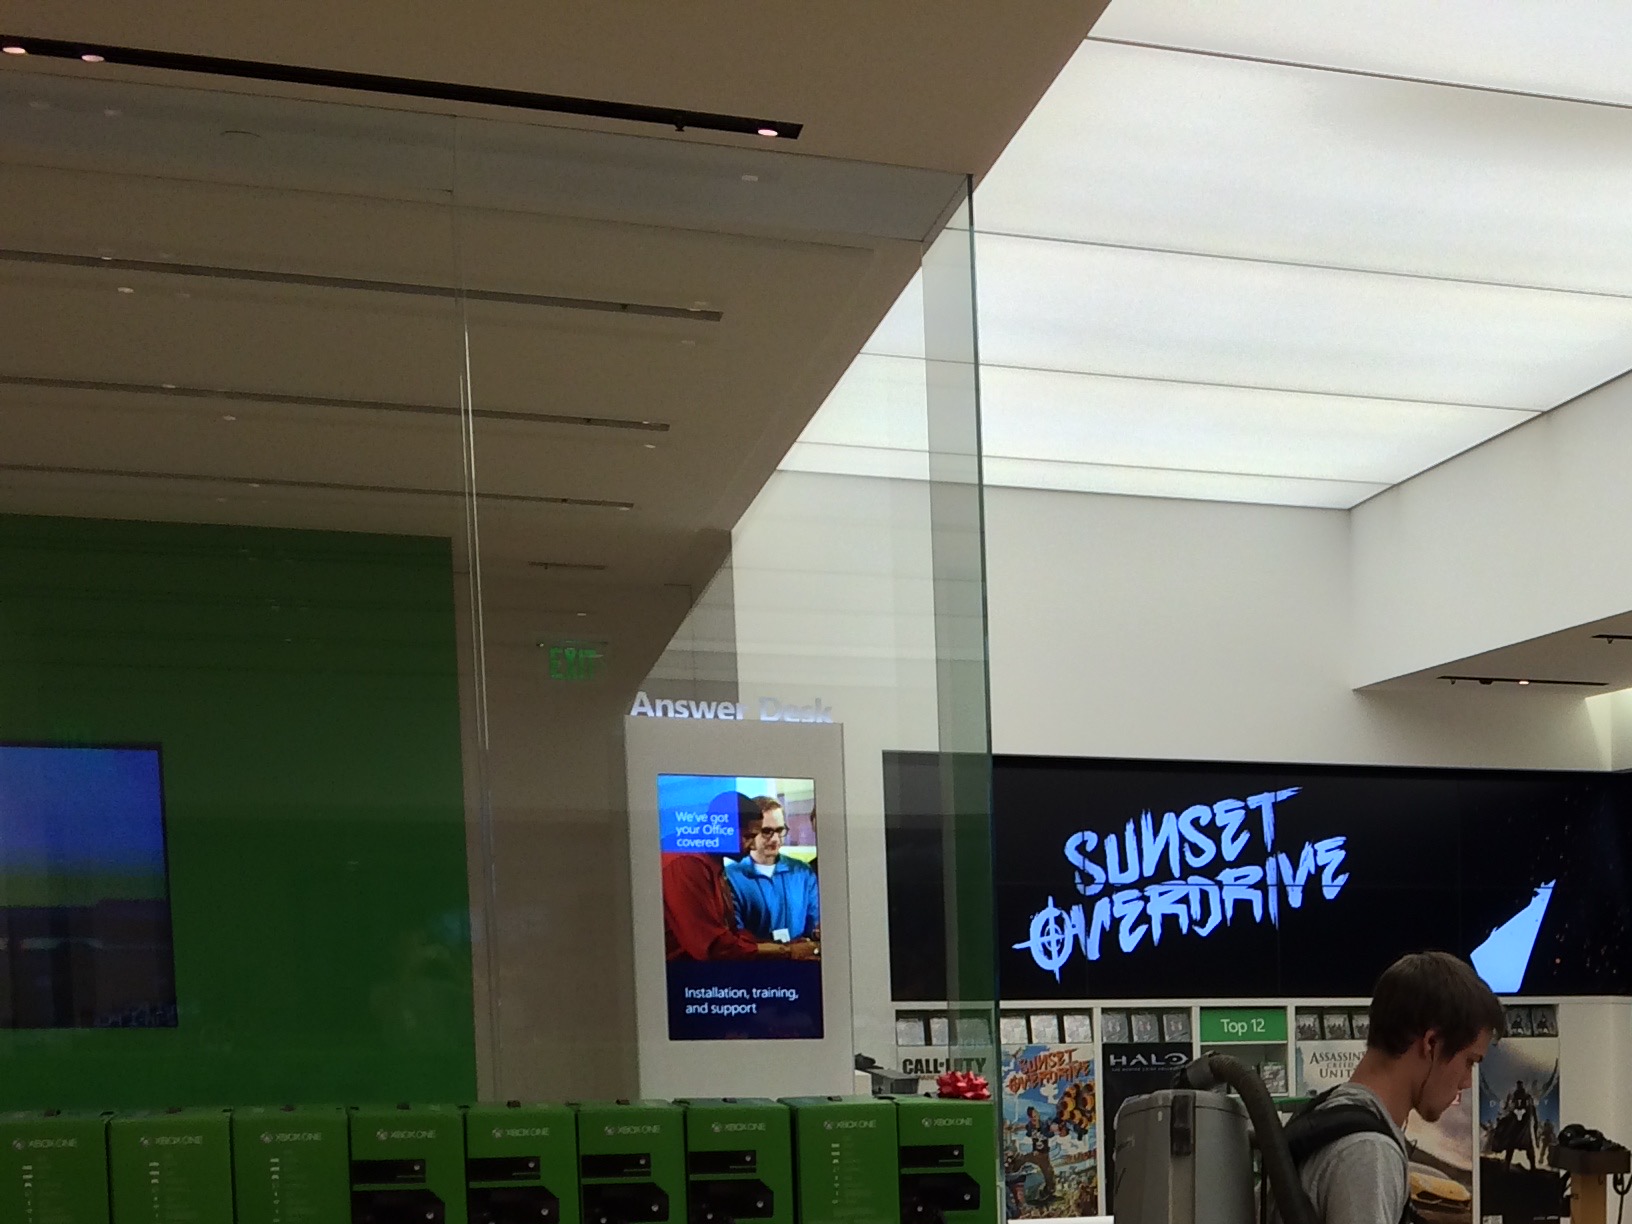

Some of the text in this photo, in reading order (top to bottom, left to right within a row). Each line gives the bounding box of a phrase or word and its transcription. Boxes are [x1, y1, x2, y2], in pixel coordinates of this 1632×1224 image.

[630, 692, 833, 723] Answer Desk
[675, 811, 729, 826] We've got
[676, 824, 734, 837] your Office
[676, 837, 719, 848] covered
[1064, 787, 1302, 896] SUNSET
[1012, 836, 1350, 984] OVERDRIVE
[685, 986, 799, 1001] Installation, training,
[686, 1002, 757, 1017] and support
[1221, 1019, 1265, 1036] Top 12
[902, 1058, 941, 1075] CALL
[1019, 1048, 1078, 1074] SUNSET
[1110, 1052, 1189, 1066] HALO
[1320, 1068, 1354, 1079] UNIT
